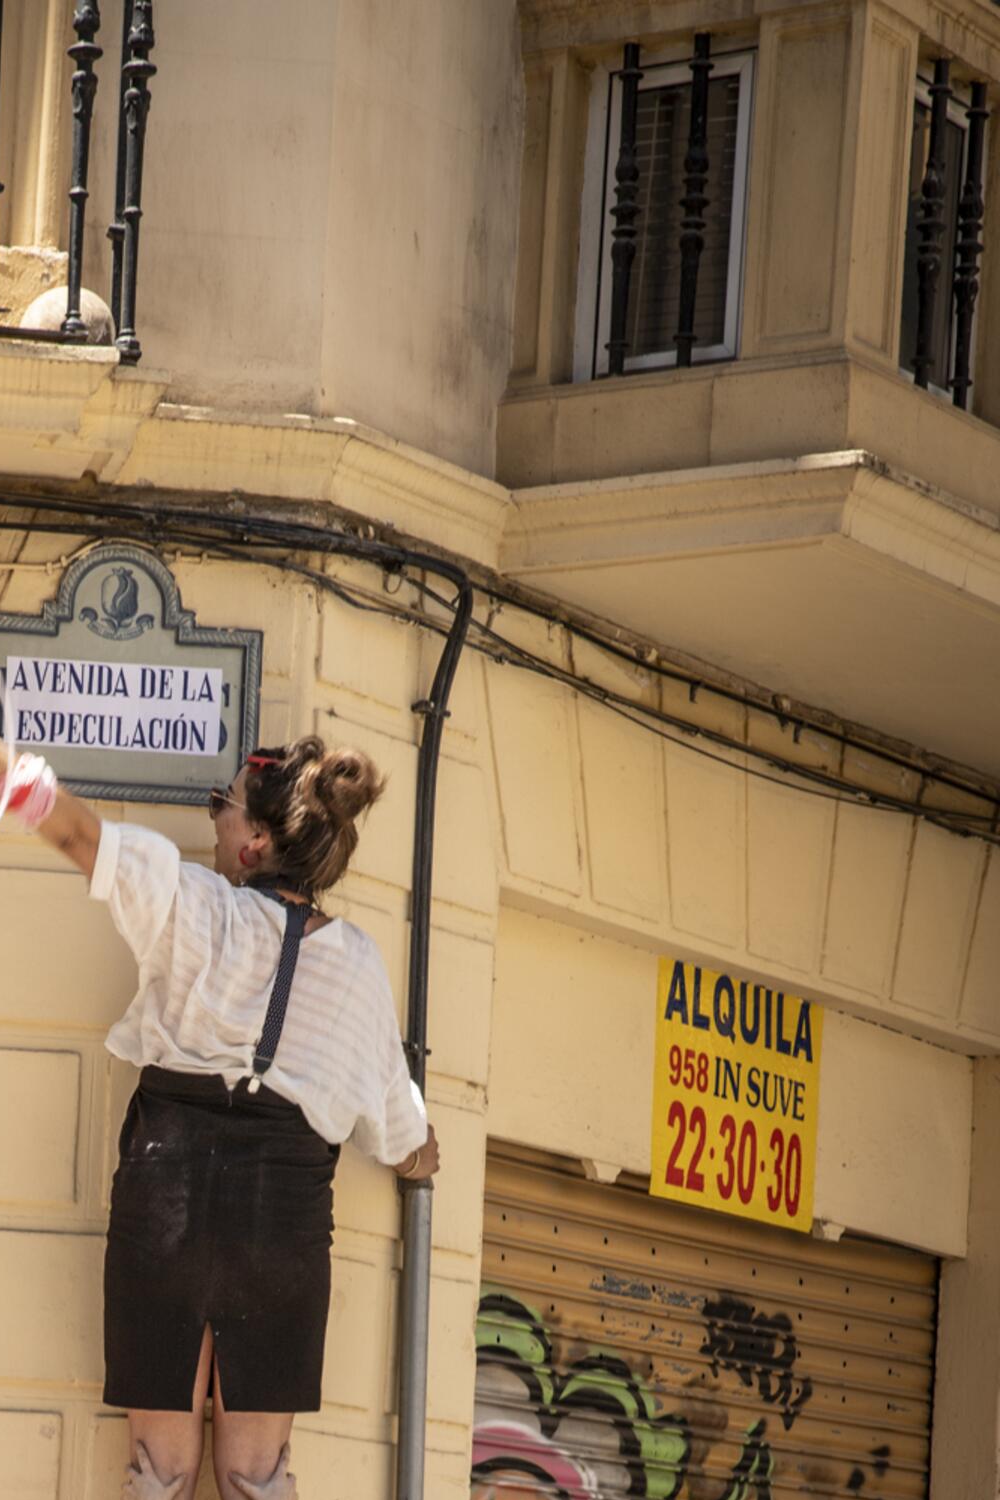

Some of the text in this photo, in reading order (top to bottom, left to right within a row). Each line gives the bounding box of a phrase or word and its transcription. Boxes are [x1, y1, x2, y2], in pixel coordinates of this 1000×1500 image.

[11, 660, 130, 698] AVENIDA
[139, 667, 174, 700] DE
[182, 670, 216, 703] LA
[15, 709, 209, 753] ESPECULACIÓN
[664, 960, 813, 1064] ALQUILA
[668, 1044, 709, 1094] 958
